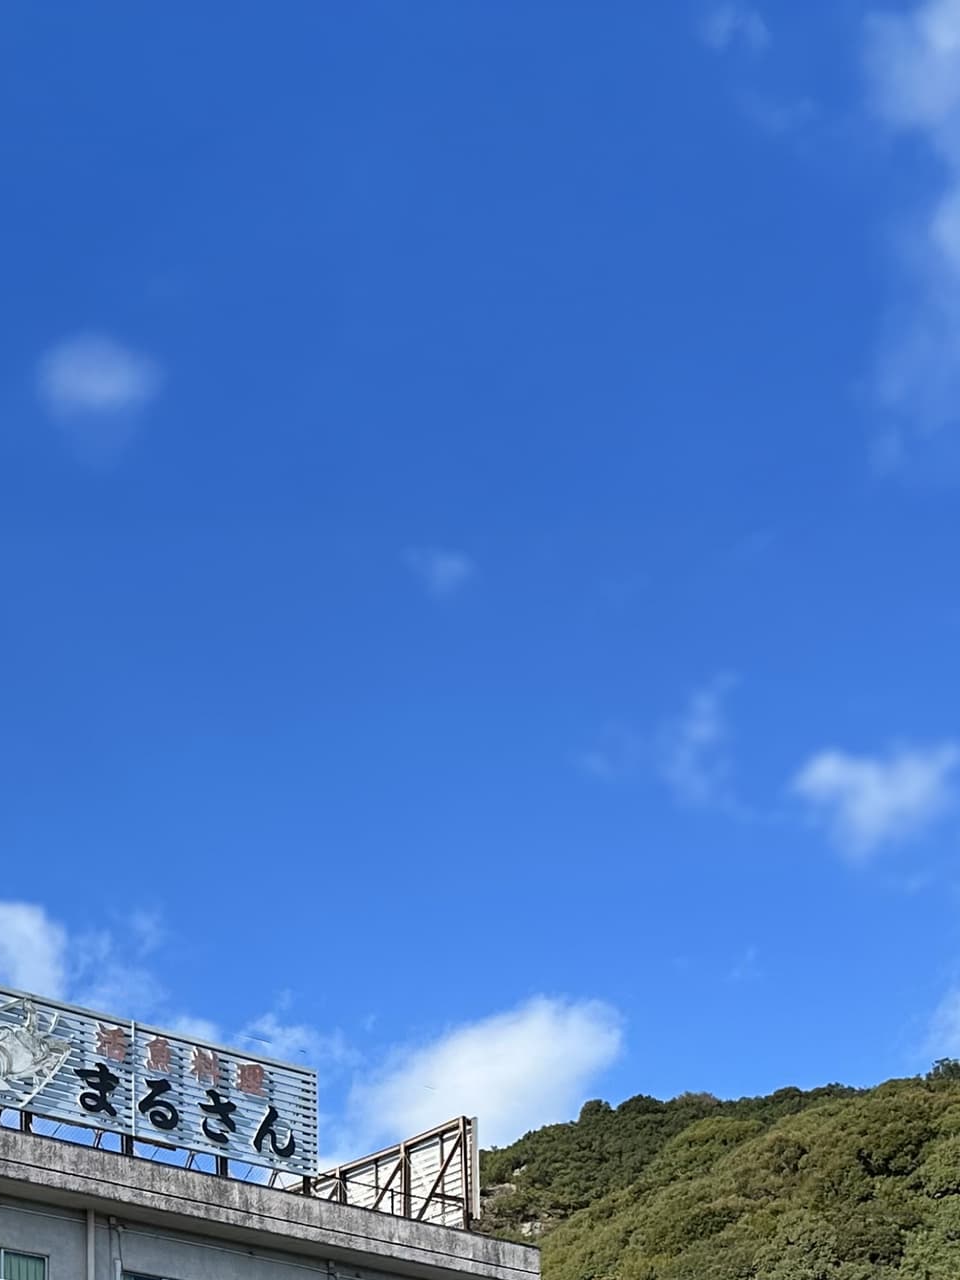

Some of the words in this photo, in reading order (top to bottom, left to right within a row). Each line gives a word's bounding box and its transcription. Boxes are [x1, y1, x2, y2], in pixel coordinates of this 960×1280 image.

[95, 1022, 267, 1097] 活魚料理
[73, 1062, 296, 1157] まるさん
